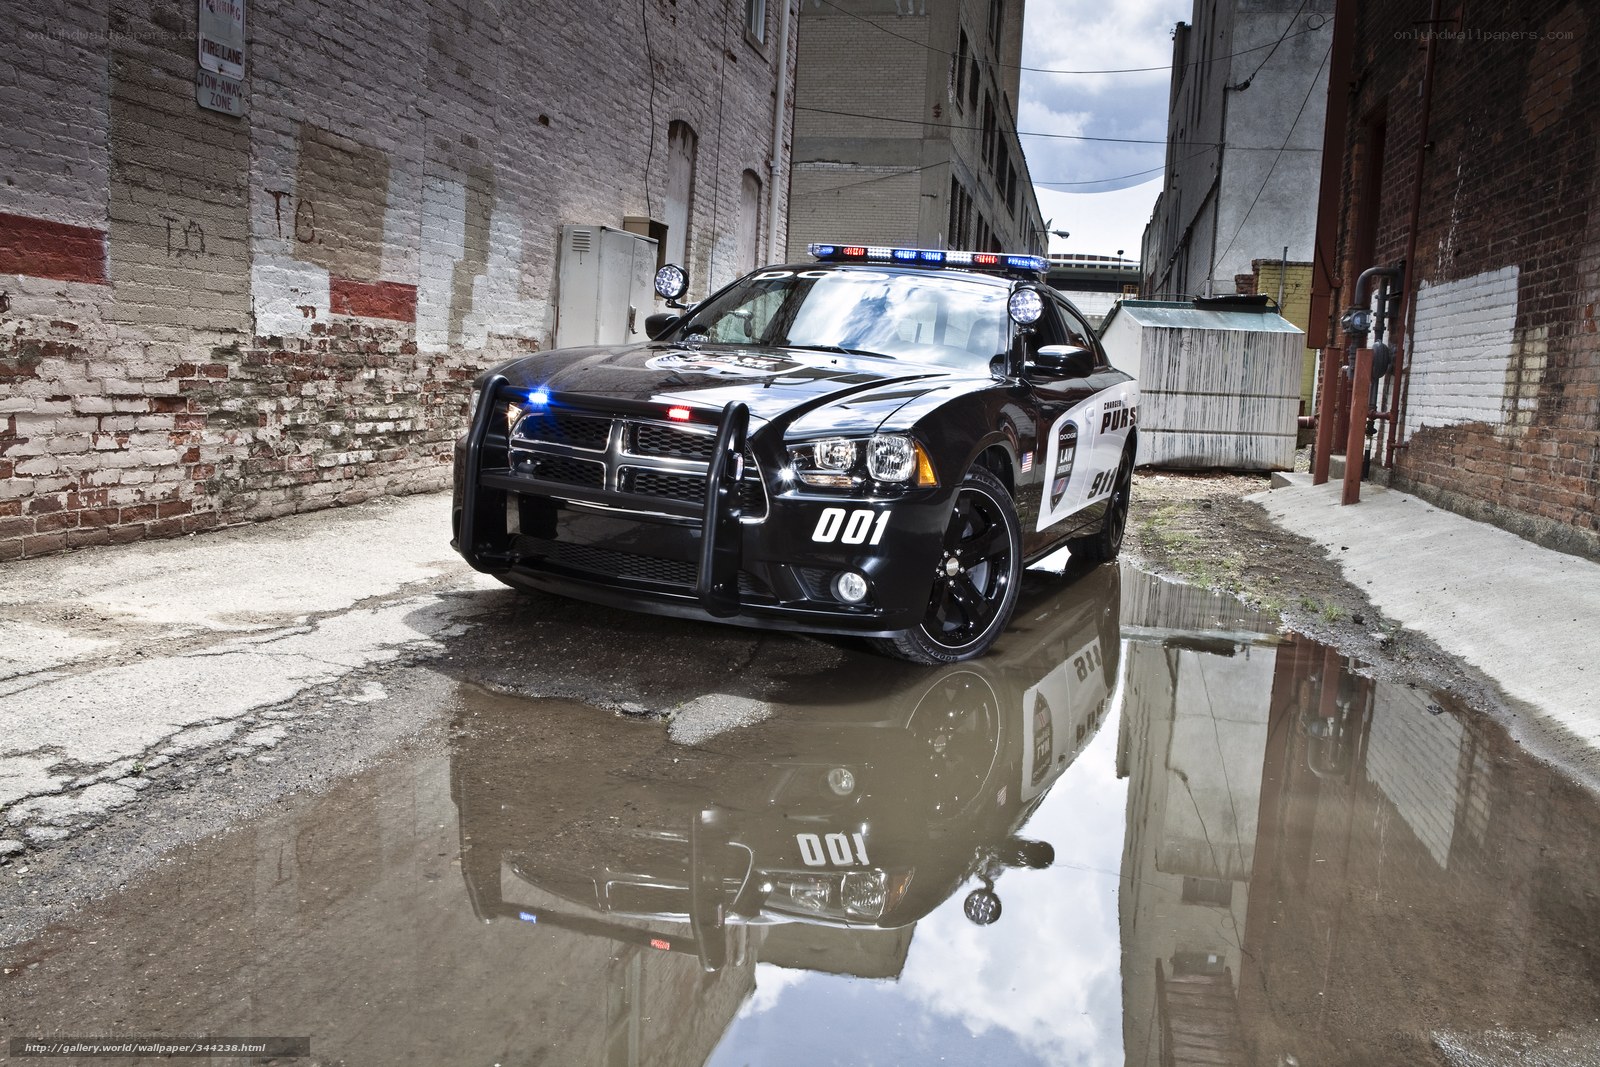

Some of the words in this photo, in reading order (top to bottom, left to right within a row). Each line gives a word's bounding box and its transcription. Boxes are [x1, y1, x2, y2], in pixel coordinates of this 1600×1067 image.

[202, 39, 220, 58] FIRE
[221, 44, 242, 66] LANE
[200, 72, 241, 97] TOW-AWAY
[210, 92, 232, 111] ZONE
[1059, 432, 1077, 441] DODGE
[1059, 447, 1074, 464] LAW
[1087, 466, 1118, 500] 911
[811, 507, 892, 546] 001
